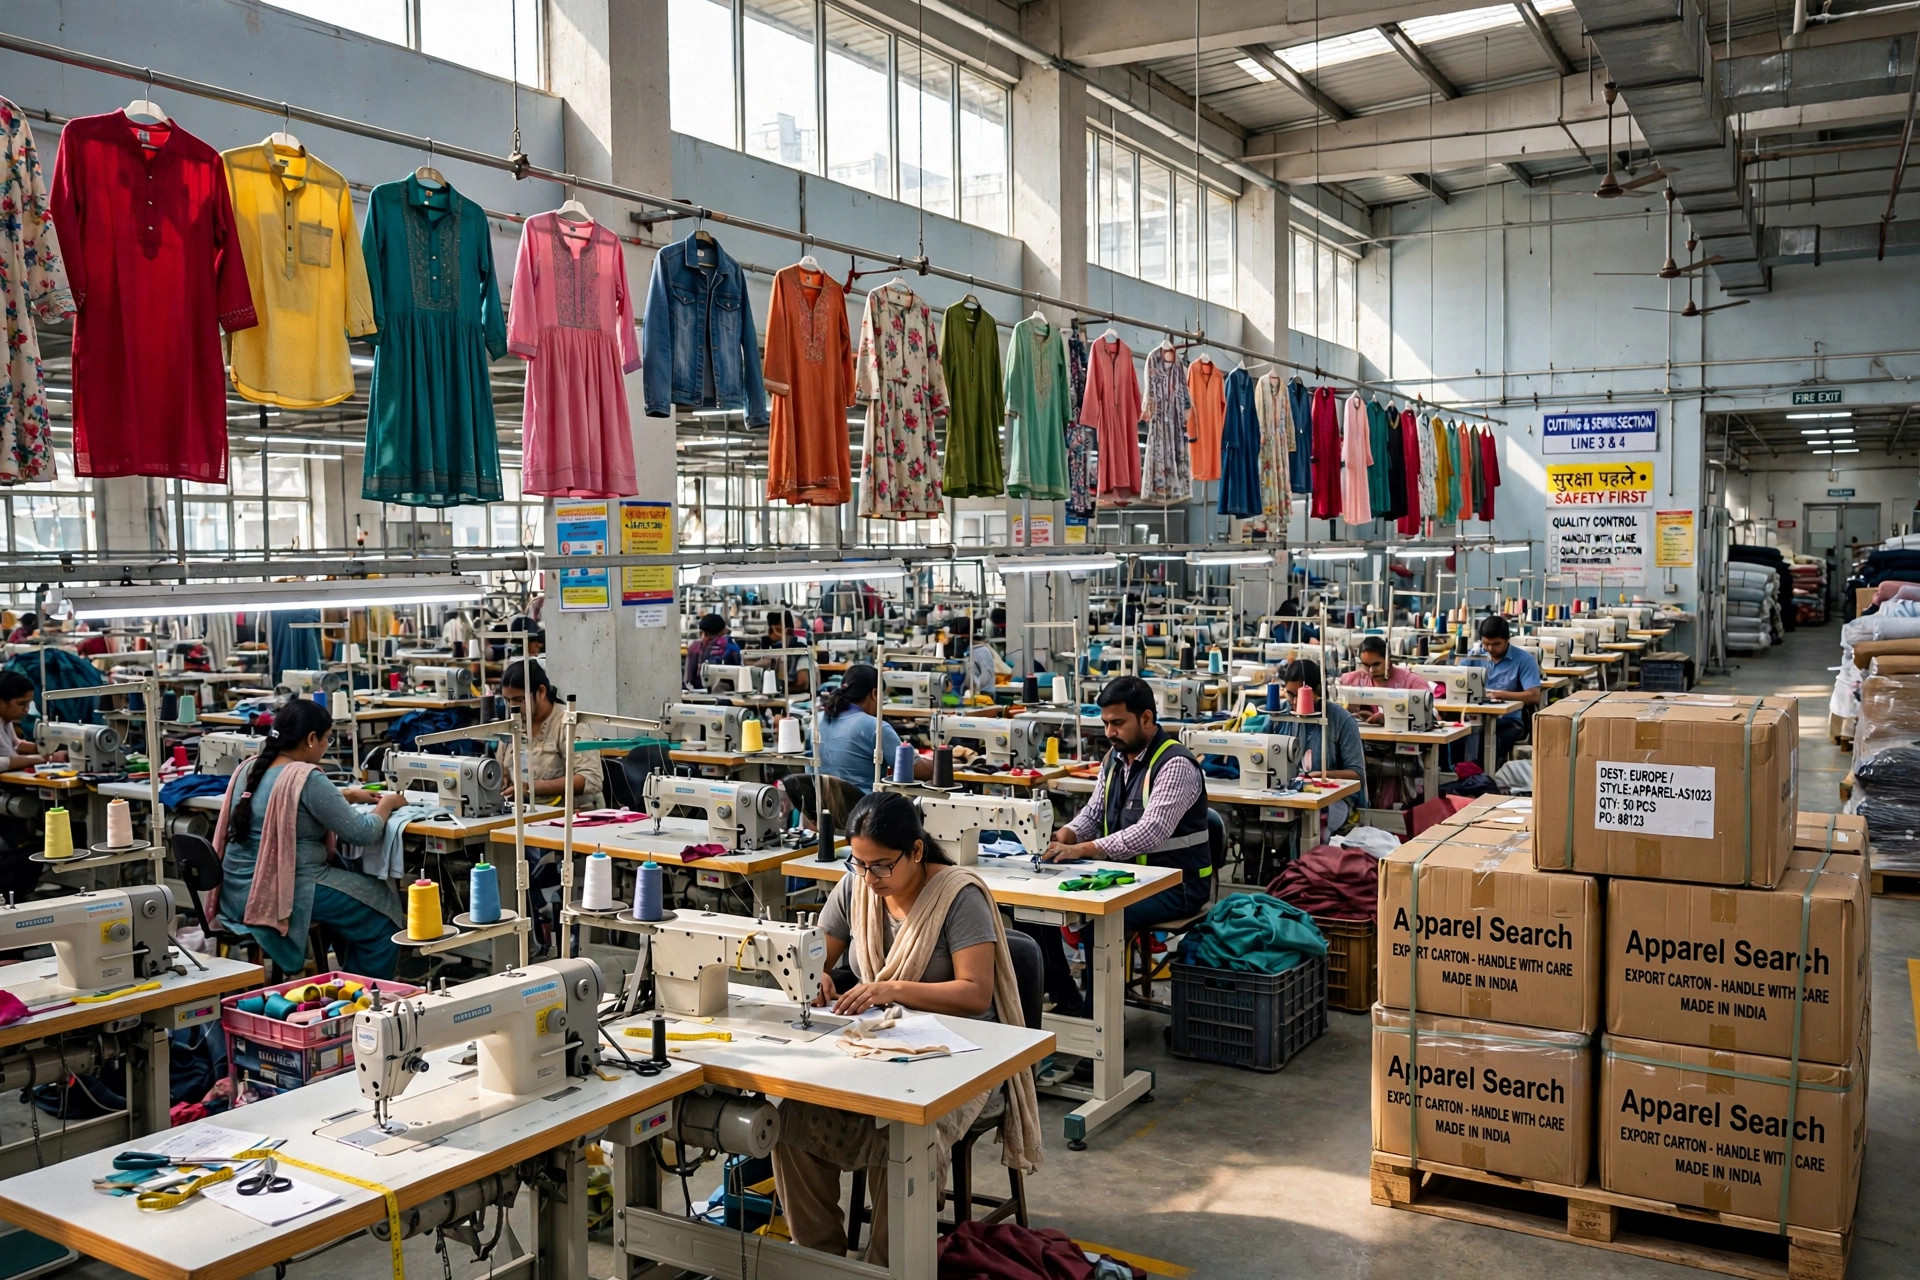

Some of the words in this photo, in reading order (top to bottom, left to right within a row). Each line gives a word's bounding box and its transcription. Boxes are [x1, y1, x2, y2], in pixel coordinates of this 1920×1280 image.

[1795, 393, 1815, 403] FIRE
[1818, 392, 1840, 402] EXIT
[1547, 418, 1582, 431] CUTTING
[1618, 414, 1652, 429] SECTION
[1571, 437, 1595, 449] LINE
[1598, 436, 1605, 449] 3
[1608, 436, 1616, 448] &
[1619, 436, 1626, 448] 4
[1552, 471, 1593, 492] सुरक्षा
[1598, 465, 1637, 488] पहले
[1555, 492, 1605, 505] SAFETY
[1608, 490, 1648, 504] FIRST
[1552, 516, 1591, 529] QUALITY
[1593, 515, 1638, 528] CONTROL
[1600, 767, 1627, 781] DEST:
[1629, 769, 1668, 783] EUROPE
[1600, 782, 1631, 796] STYLE:
[1632, 784, 1712, 801] APPAREL-AS1023
[1599, 797, 1620, 810] QTY:
[1623, 799, 1634, 811] 50
[1636, 799, 1657, 813] PCS
[1599, 812, 1615, 824] PO:
[1618, 813, 1645, 827] 88123
[1489, 916, 1573, 949] Search
[1393, 943, 1430, 960] EXPRT
[1431, 948, 1470, 965] CARTON
[1477, 953, 1517, 970] HANDLE
[1519, 958, 1544, 974] WITH
[1546, 962, 1573, 977] CARE
[1625, 929, 1725, 964] Apparel
[1733, 939, 1830, 975] Search
[1442, 970, 1472, 986] MADE
[1475, 974, 1486, 988] IN
[1489, 976, 1519, 992] INDIA
[1625, 968, 1666, 986] EXPORT
[1667, 972, 1712, 991] CARTON
[1721, 979, 1765, 997] HANDLE
[1768, 984, 1796, 1000] WITH
[1801, 988, 1830, 1004] CARE
[1680, 997, 1715, 1014] MADE
[1717, 1001, 1730, 1015] IN
[1733, 1004, 1768, 1021] INDIA
[1482, 1068, 1565, 1104] Search
[1425, 1097, 1463, 1115] CARTON
[1471, 1104, 1510, 1122] HANDLE
[1512, 1110, 1536, 1127] WITH
[1538, 1115, 1566, 1132] CARE
[1620, 1088, 1721, 1128] Apparel
[1435, 1119, 1466, 1137] MADE
[1468, 1124, 1479, 1139] IN
[1482, 1127, 1512, 1145] INDIA
[1620, 1126, 1661, 1146] EXPORT
[1663, 1133, 1707, 1154] CARTON
[1716, 1142, 1761, 1163] HANDLE
[1795, 1155, 1826, 1173] CARE
[1675, 1159, 1710, 1177] MADE
[1712, 1164, 1725, 1180] IN
[1728, 1167, 1763, 1186] INDIA
